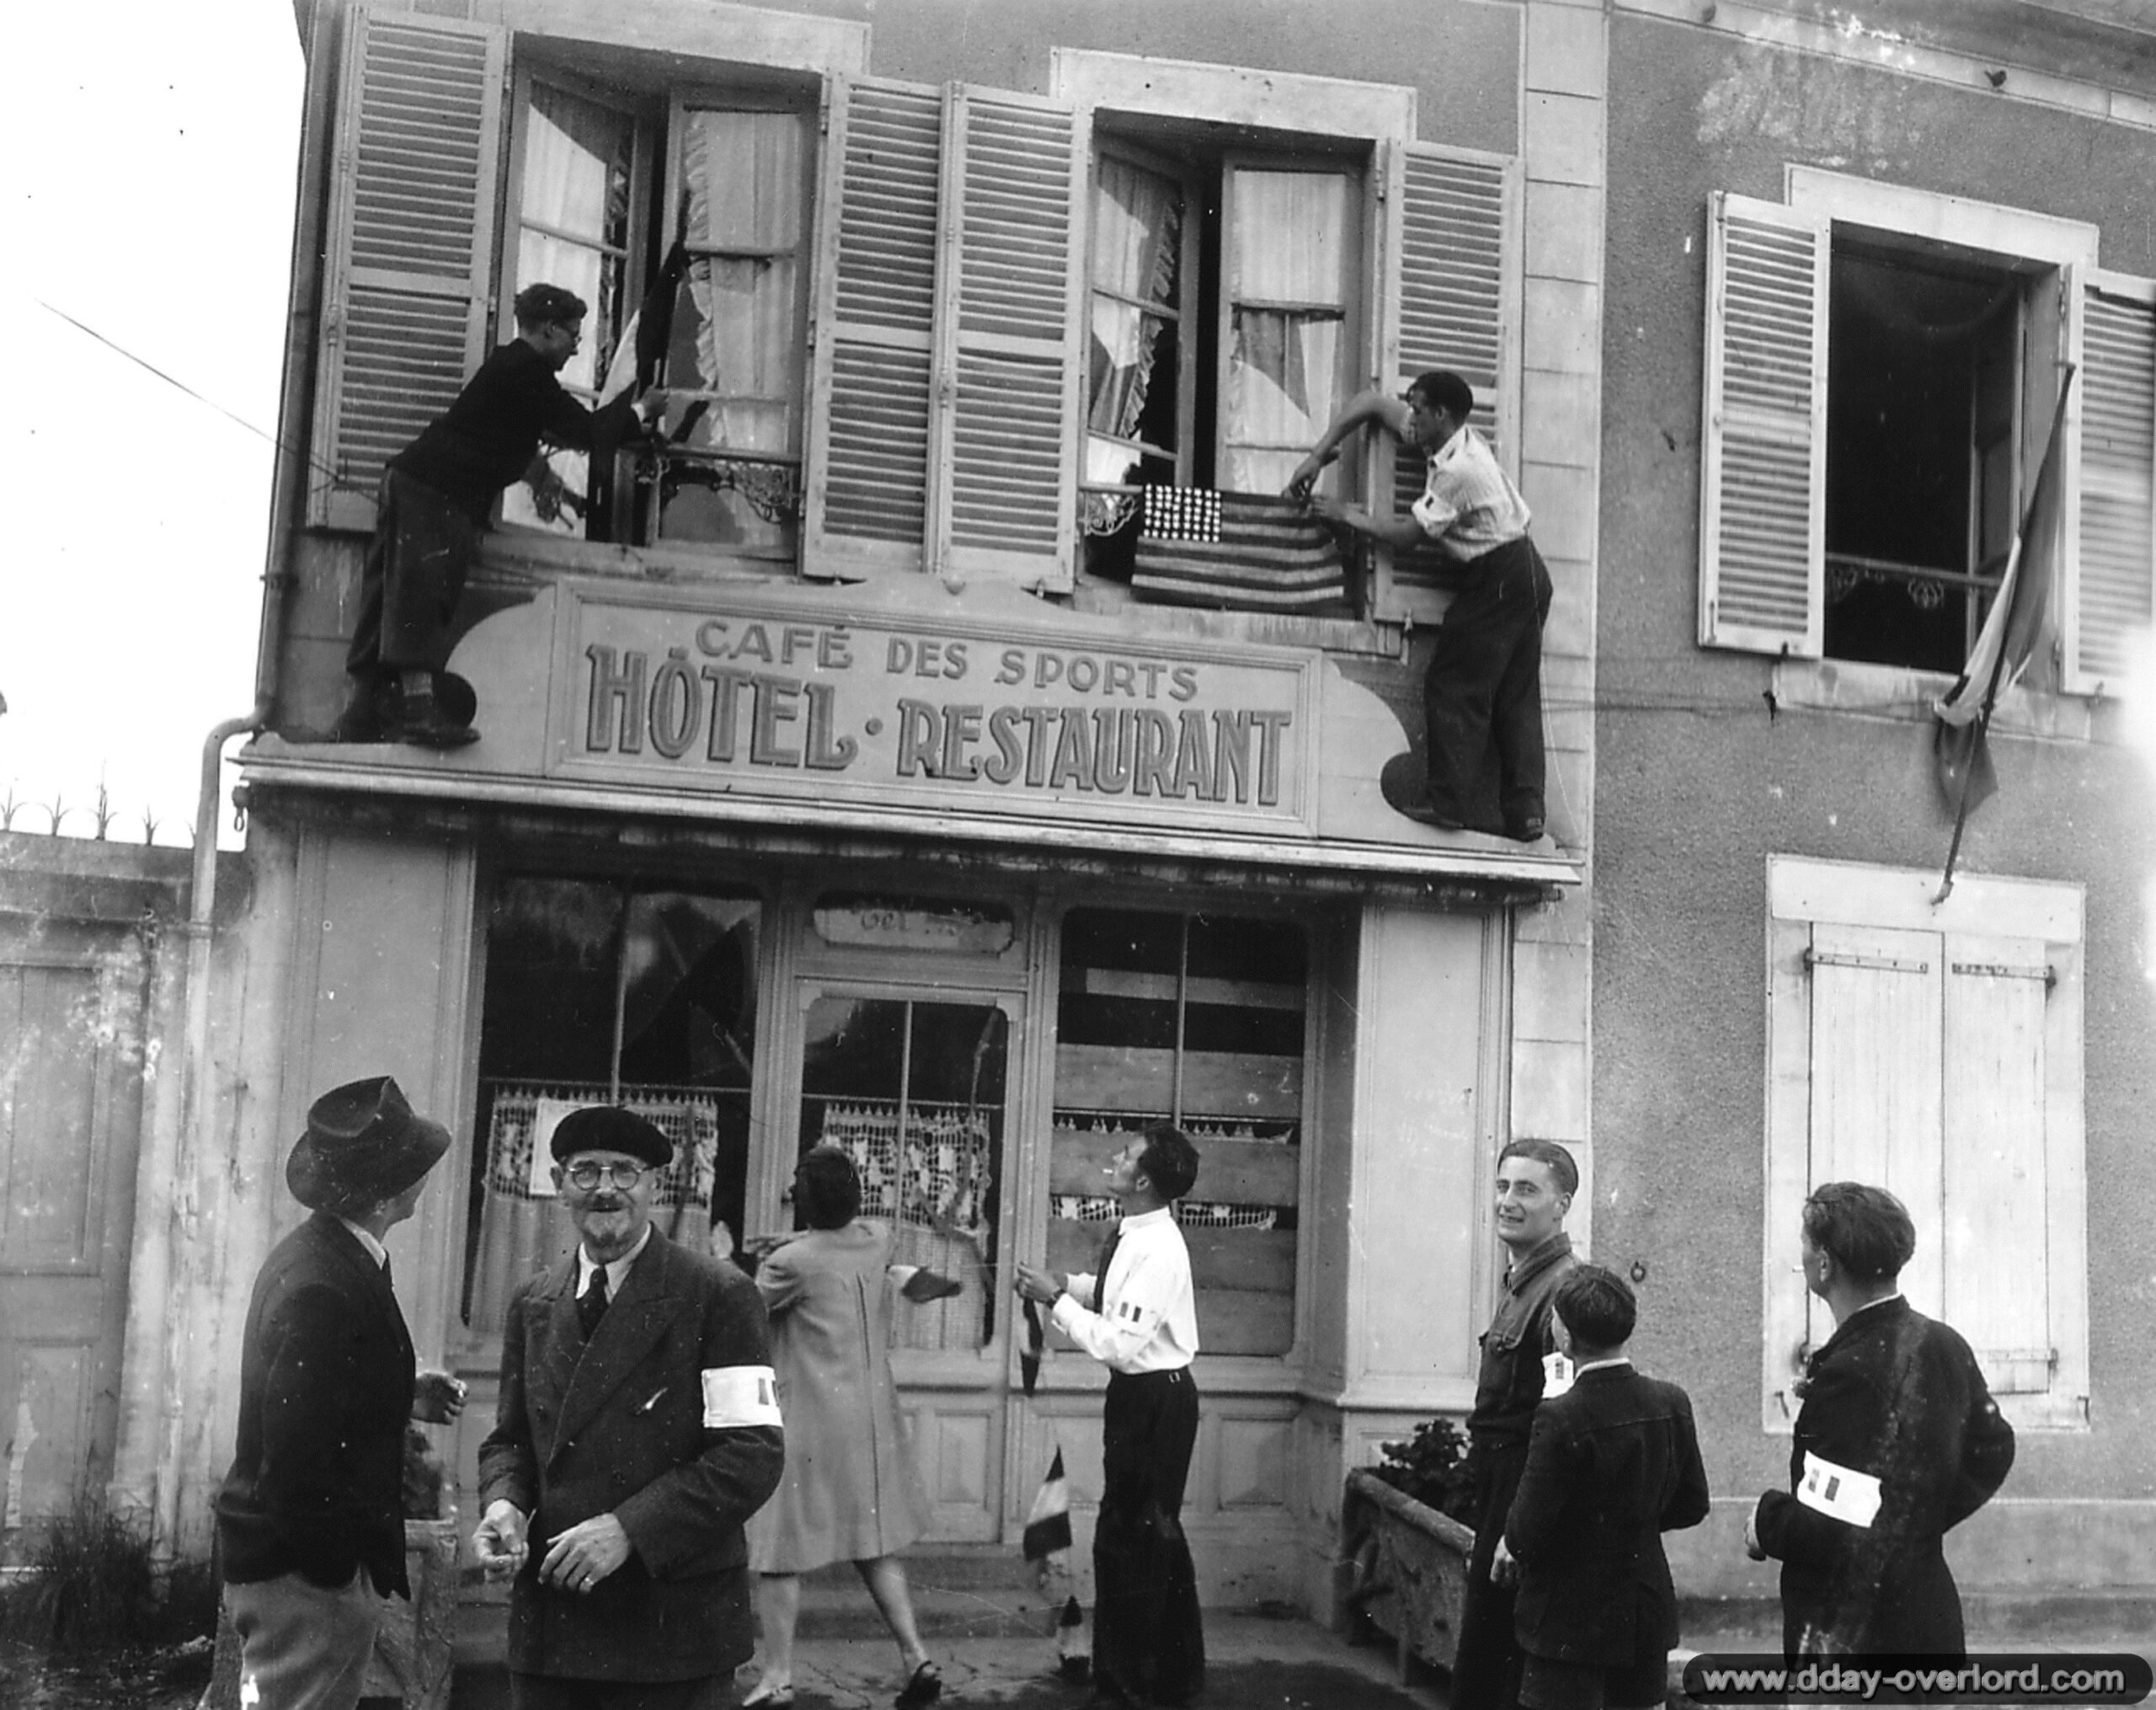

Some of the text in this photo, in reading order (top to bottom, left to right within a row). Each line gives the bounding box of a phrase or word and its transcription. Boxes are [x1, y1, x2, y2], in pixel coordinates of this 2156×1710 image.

[695, 620, 1198, 702] CAFÉ DES SPORTS
[896, 697, 1292, 806] RESTAURANT
